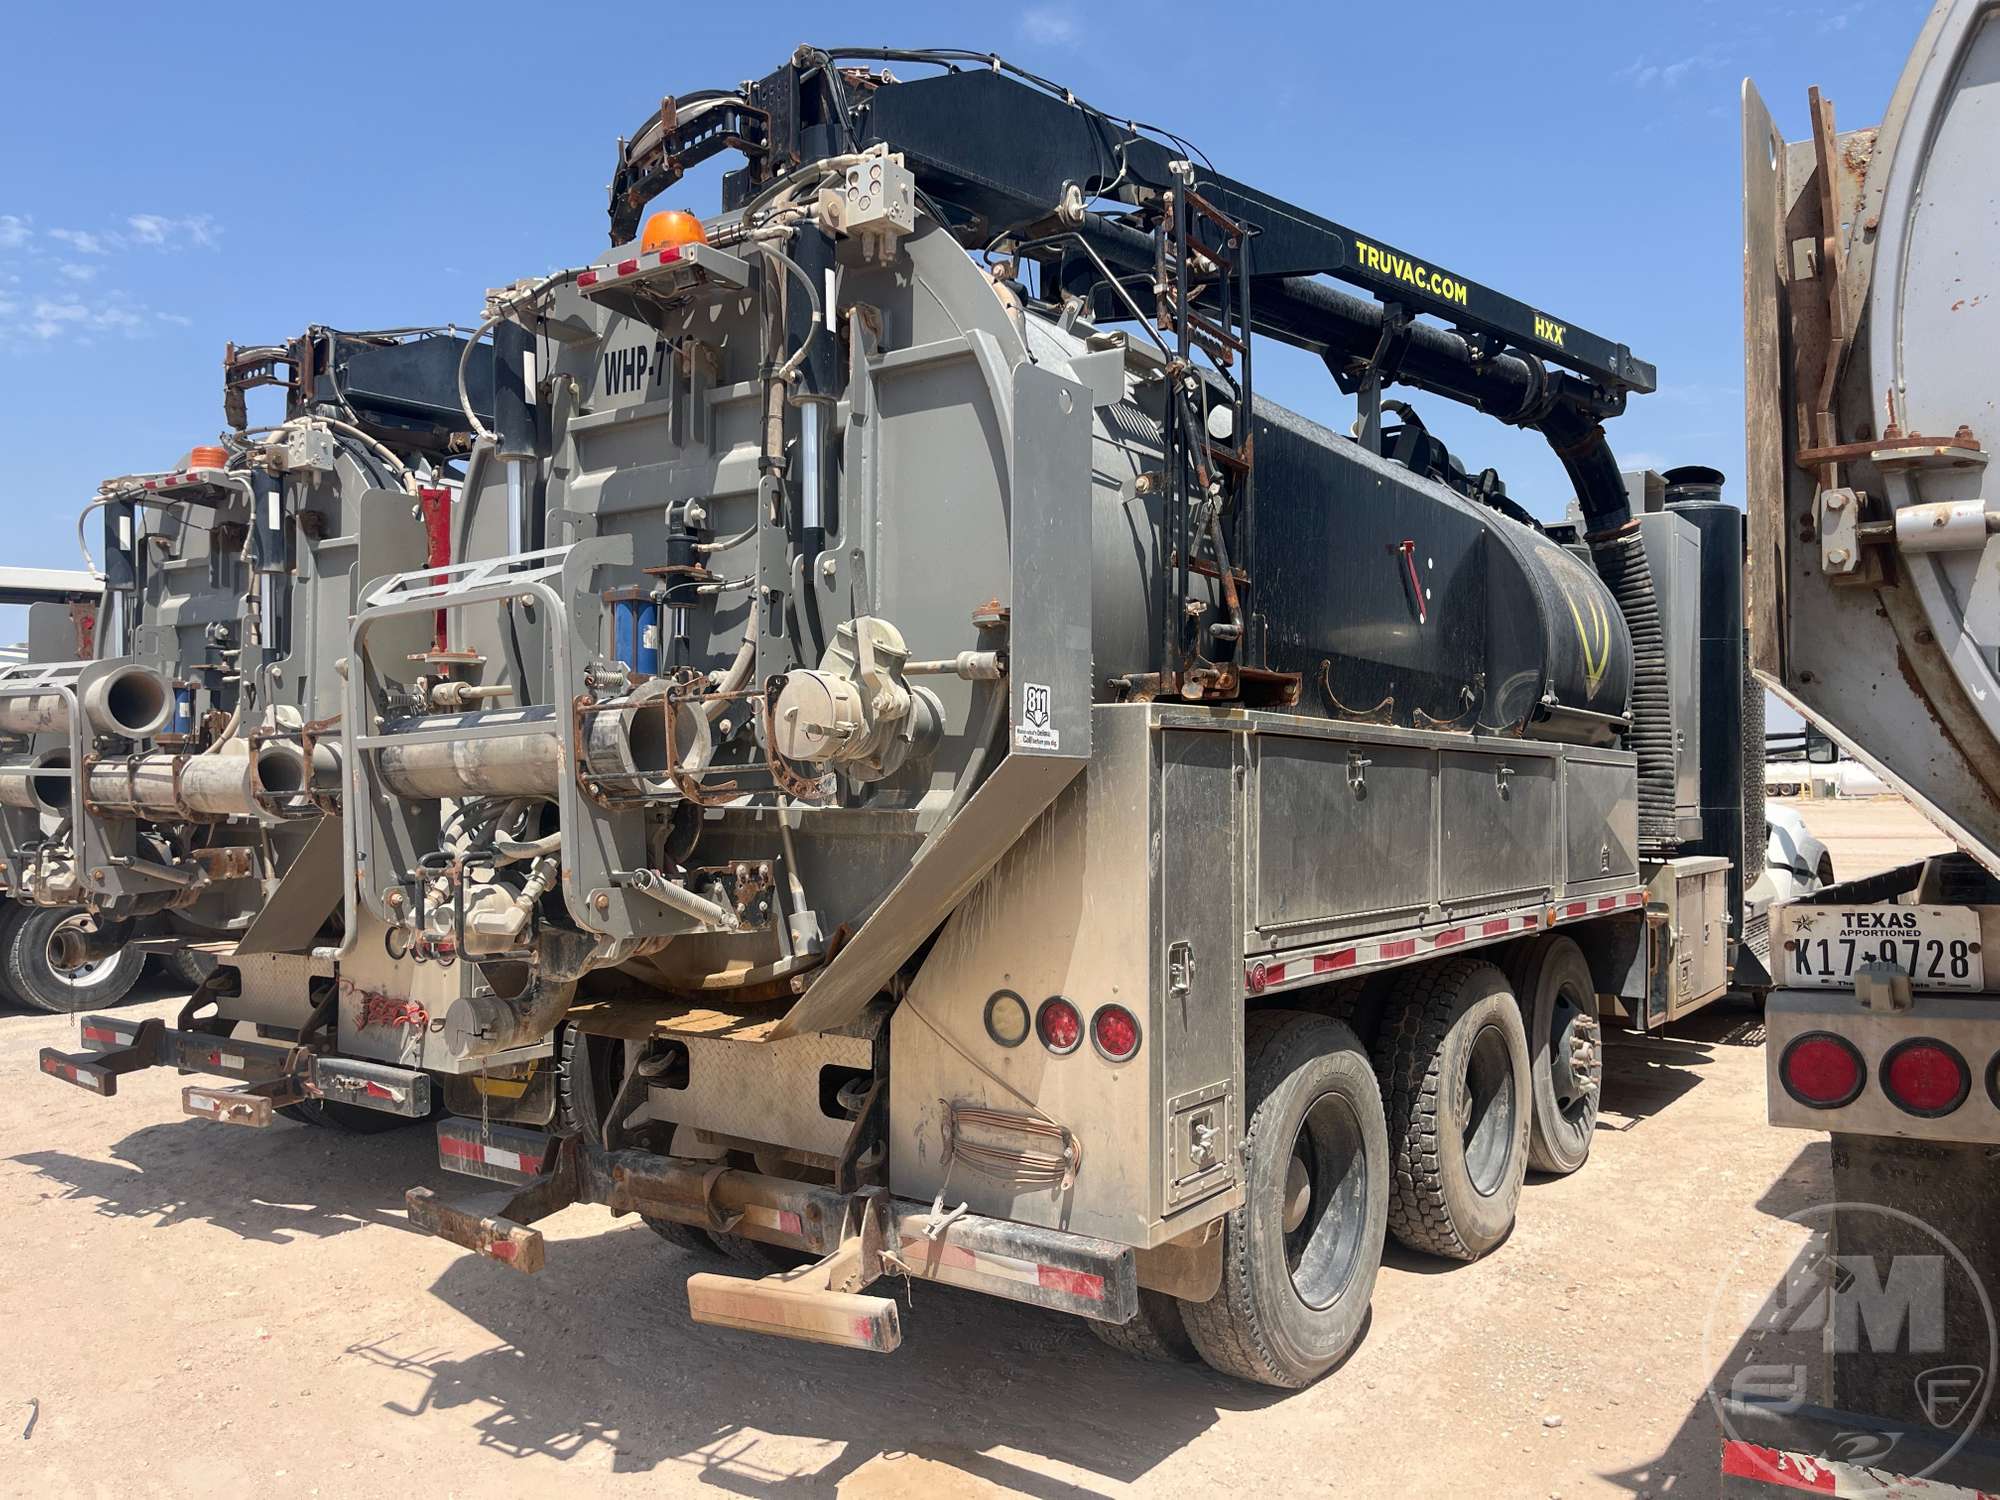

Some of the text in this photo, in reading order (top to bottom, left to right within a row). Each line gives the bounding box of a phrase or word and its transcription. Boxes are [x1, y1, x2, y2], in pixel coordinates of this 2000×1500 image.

[1356, 241, 1467, 305] TRUVAC.COM
[1027, 687, 1048, 712] 811
[1842, 912, 1917, 928] TEXAS
[1839, 929, 1922, 937] APPORTIONED
[1794, 938, 1856, 976] K17
